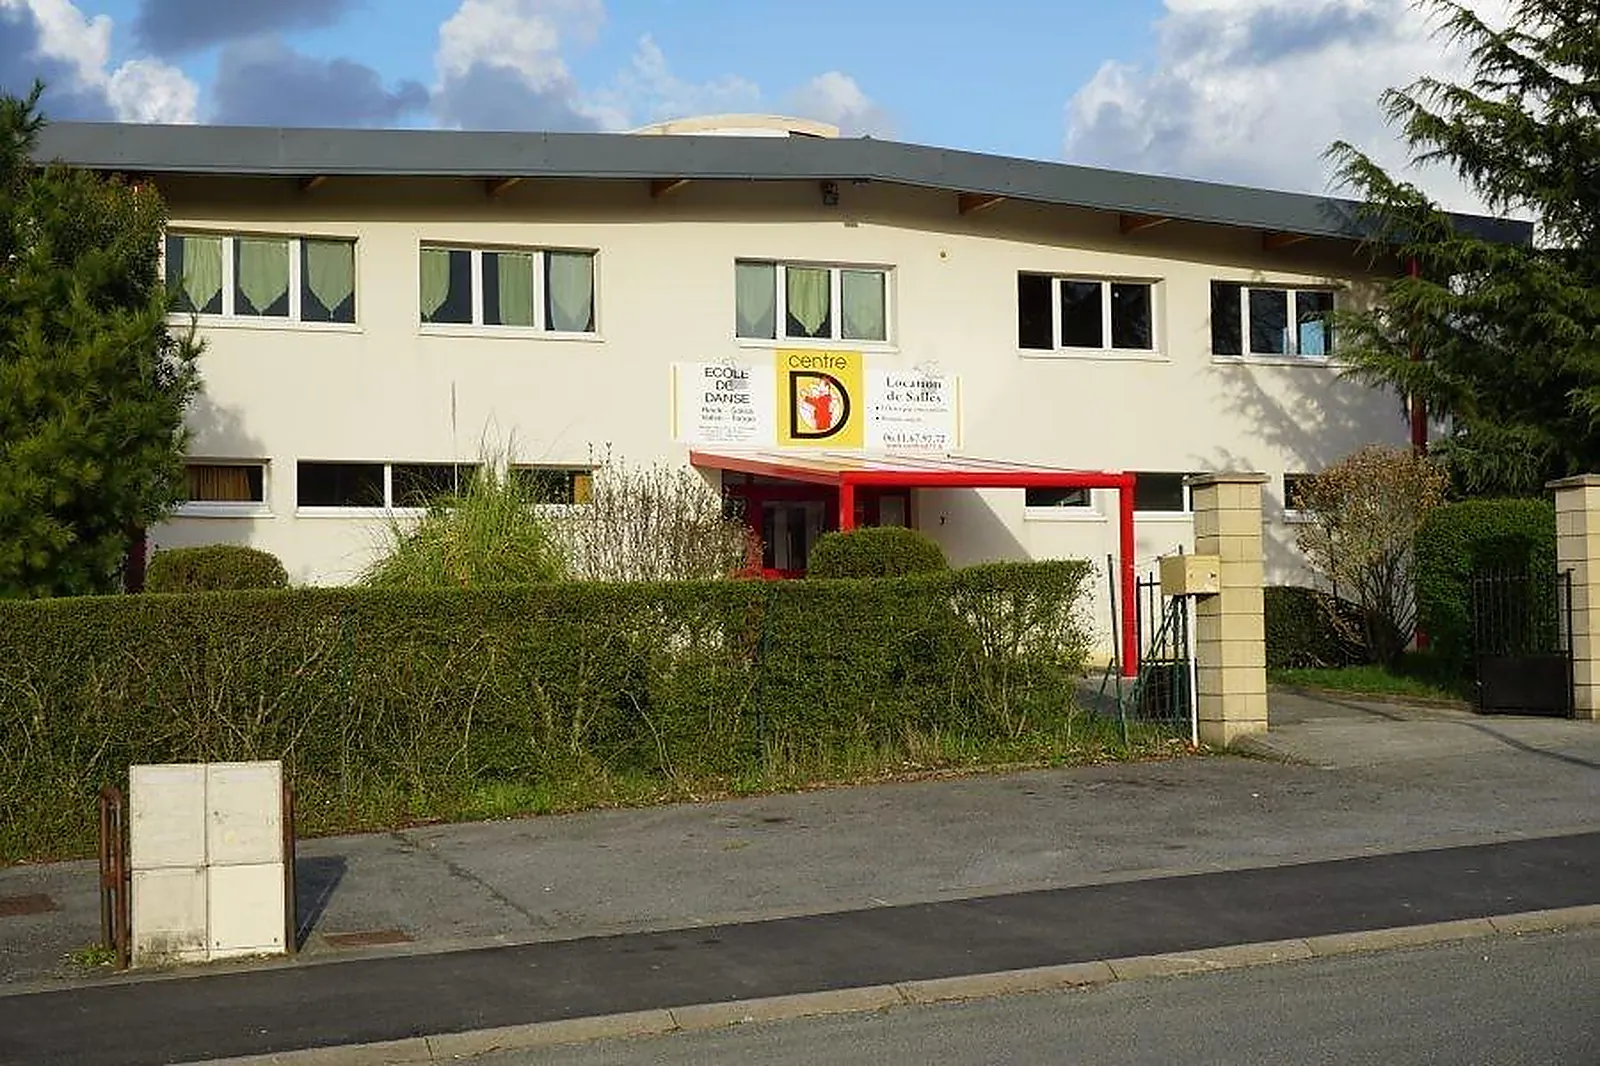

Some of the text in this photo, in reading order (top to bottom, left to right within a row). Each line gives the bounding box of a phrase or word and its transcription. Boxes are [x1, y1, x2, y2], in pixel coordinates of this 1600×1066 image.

[788, 353, 847, 370] centre
[704, 367, 750, 379] ECOLE
[715, 379, 734, 391] DE
[886, 377, 942, 389] Location
[704, 392, 751, 404] DANSE
[886, 391, 942, 403] de Salles
[789, 371, 851, 439] D
